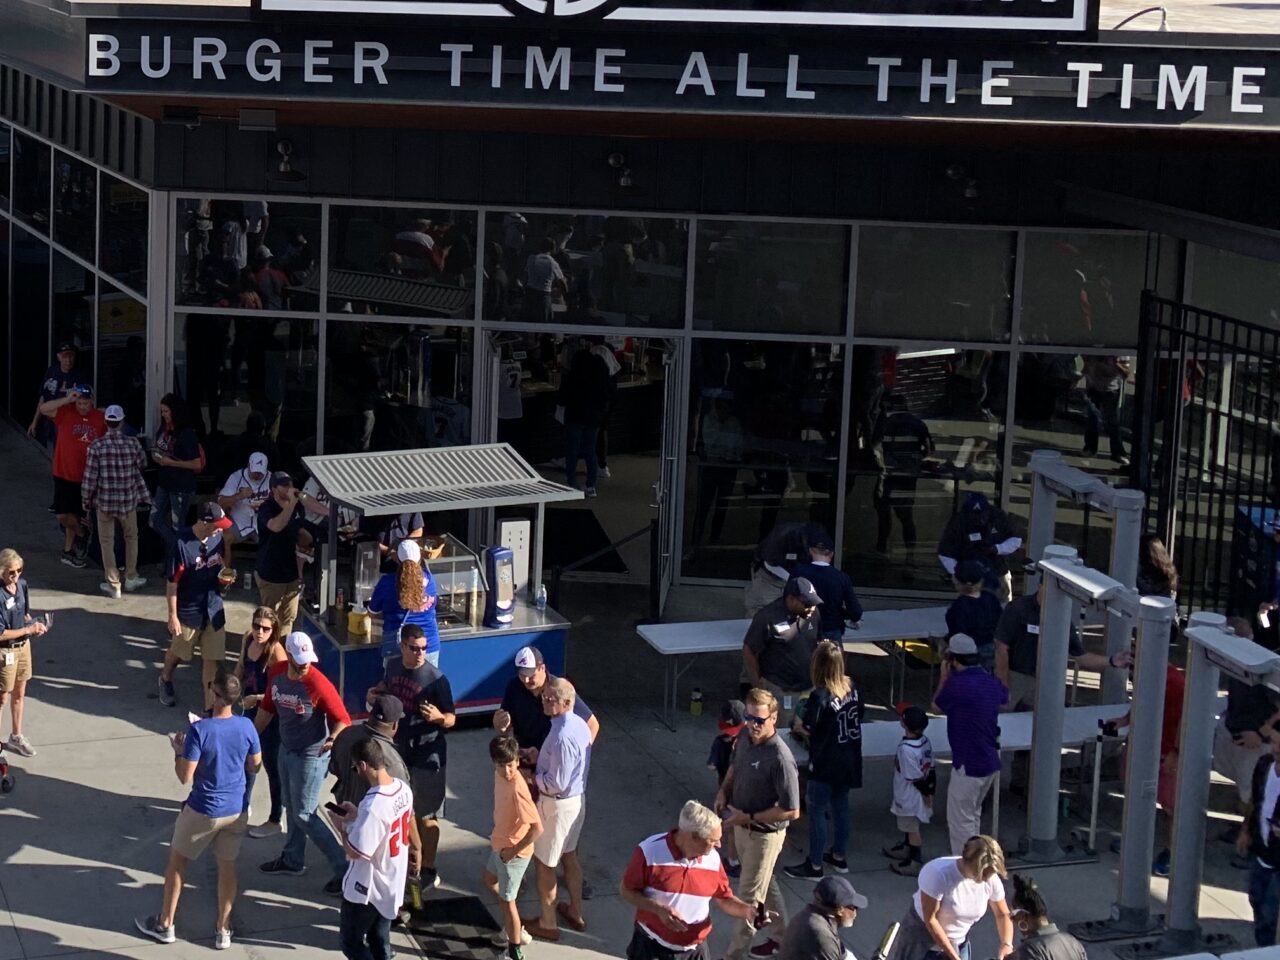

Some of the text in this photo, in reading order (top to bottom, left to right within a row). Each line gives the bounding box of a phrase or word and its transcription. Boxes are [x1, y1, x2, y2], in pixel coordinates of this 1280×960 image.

[88, 33, 1267, 114] BURGER TIME ALL THE TIME
[836, 704, 860, 744] 13
[389, 809, 411, 858] 26
